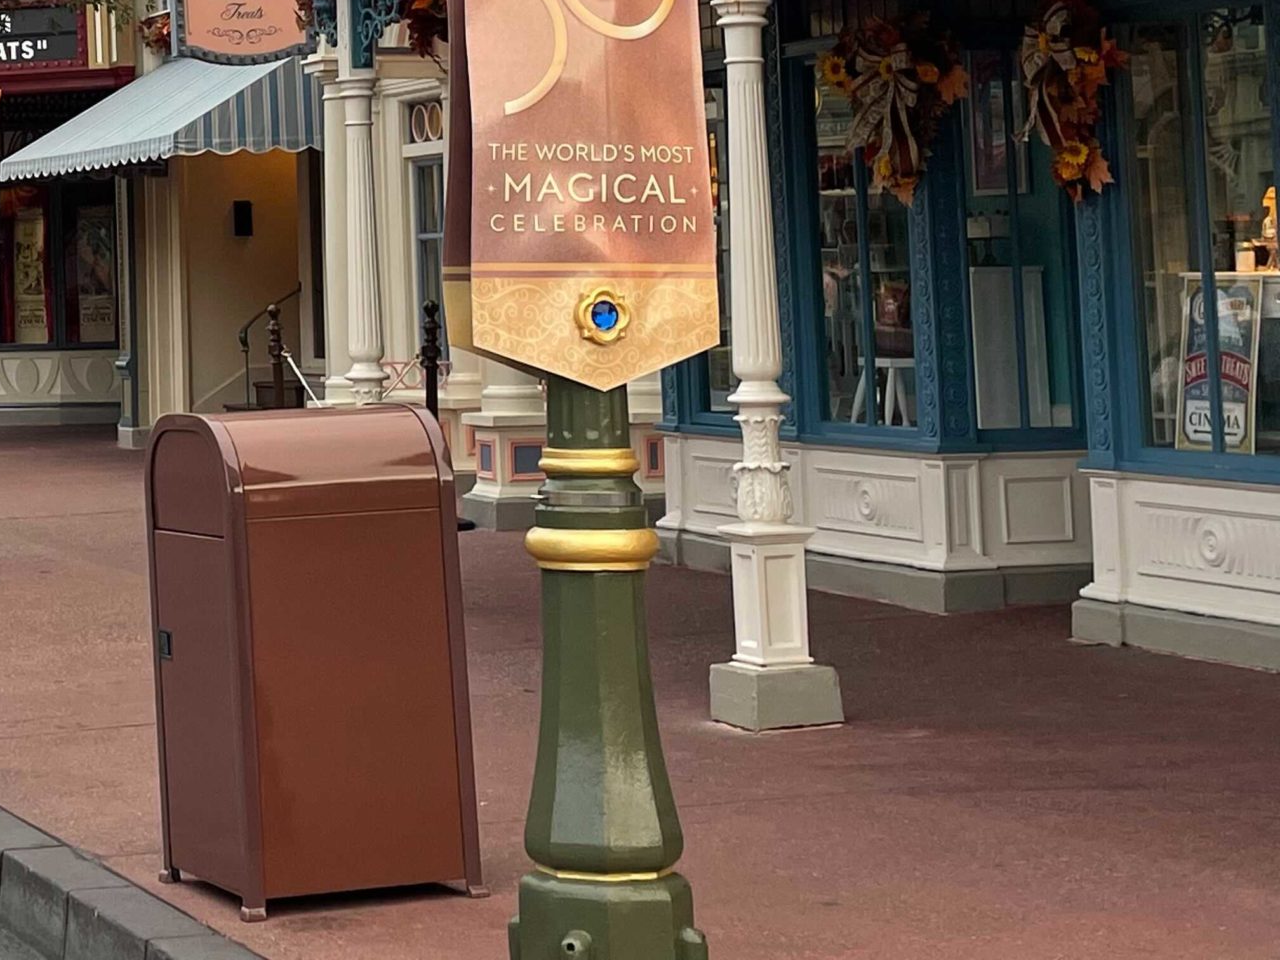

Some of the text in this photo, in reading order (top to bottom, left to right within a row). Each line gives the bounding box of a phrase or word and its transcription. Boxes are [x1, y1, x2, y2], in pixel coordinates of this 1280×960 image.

[221, 3, 264, 21] Treats
[489, 143, 694, 163] THE WORLD'S MOST
[504, 172, 686, 204] MAGICAL
[490, 213, 697, 233] CELEBRATION
